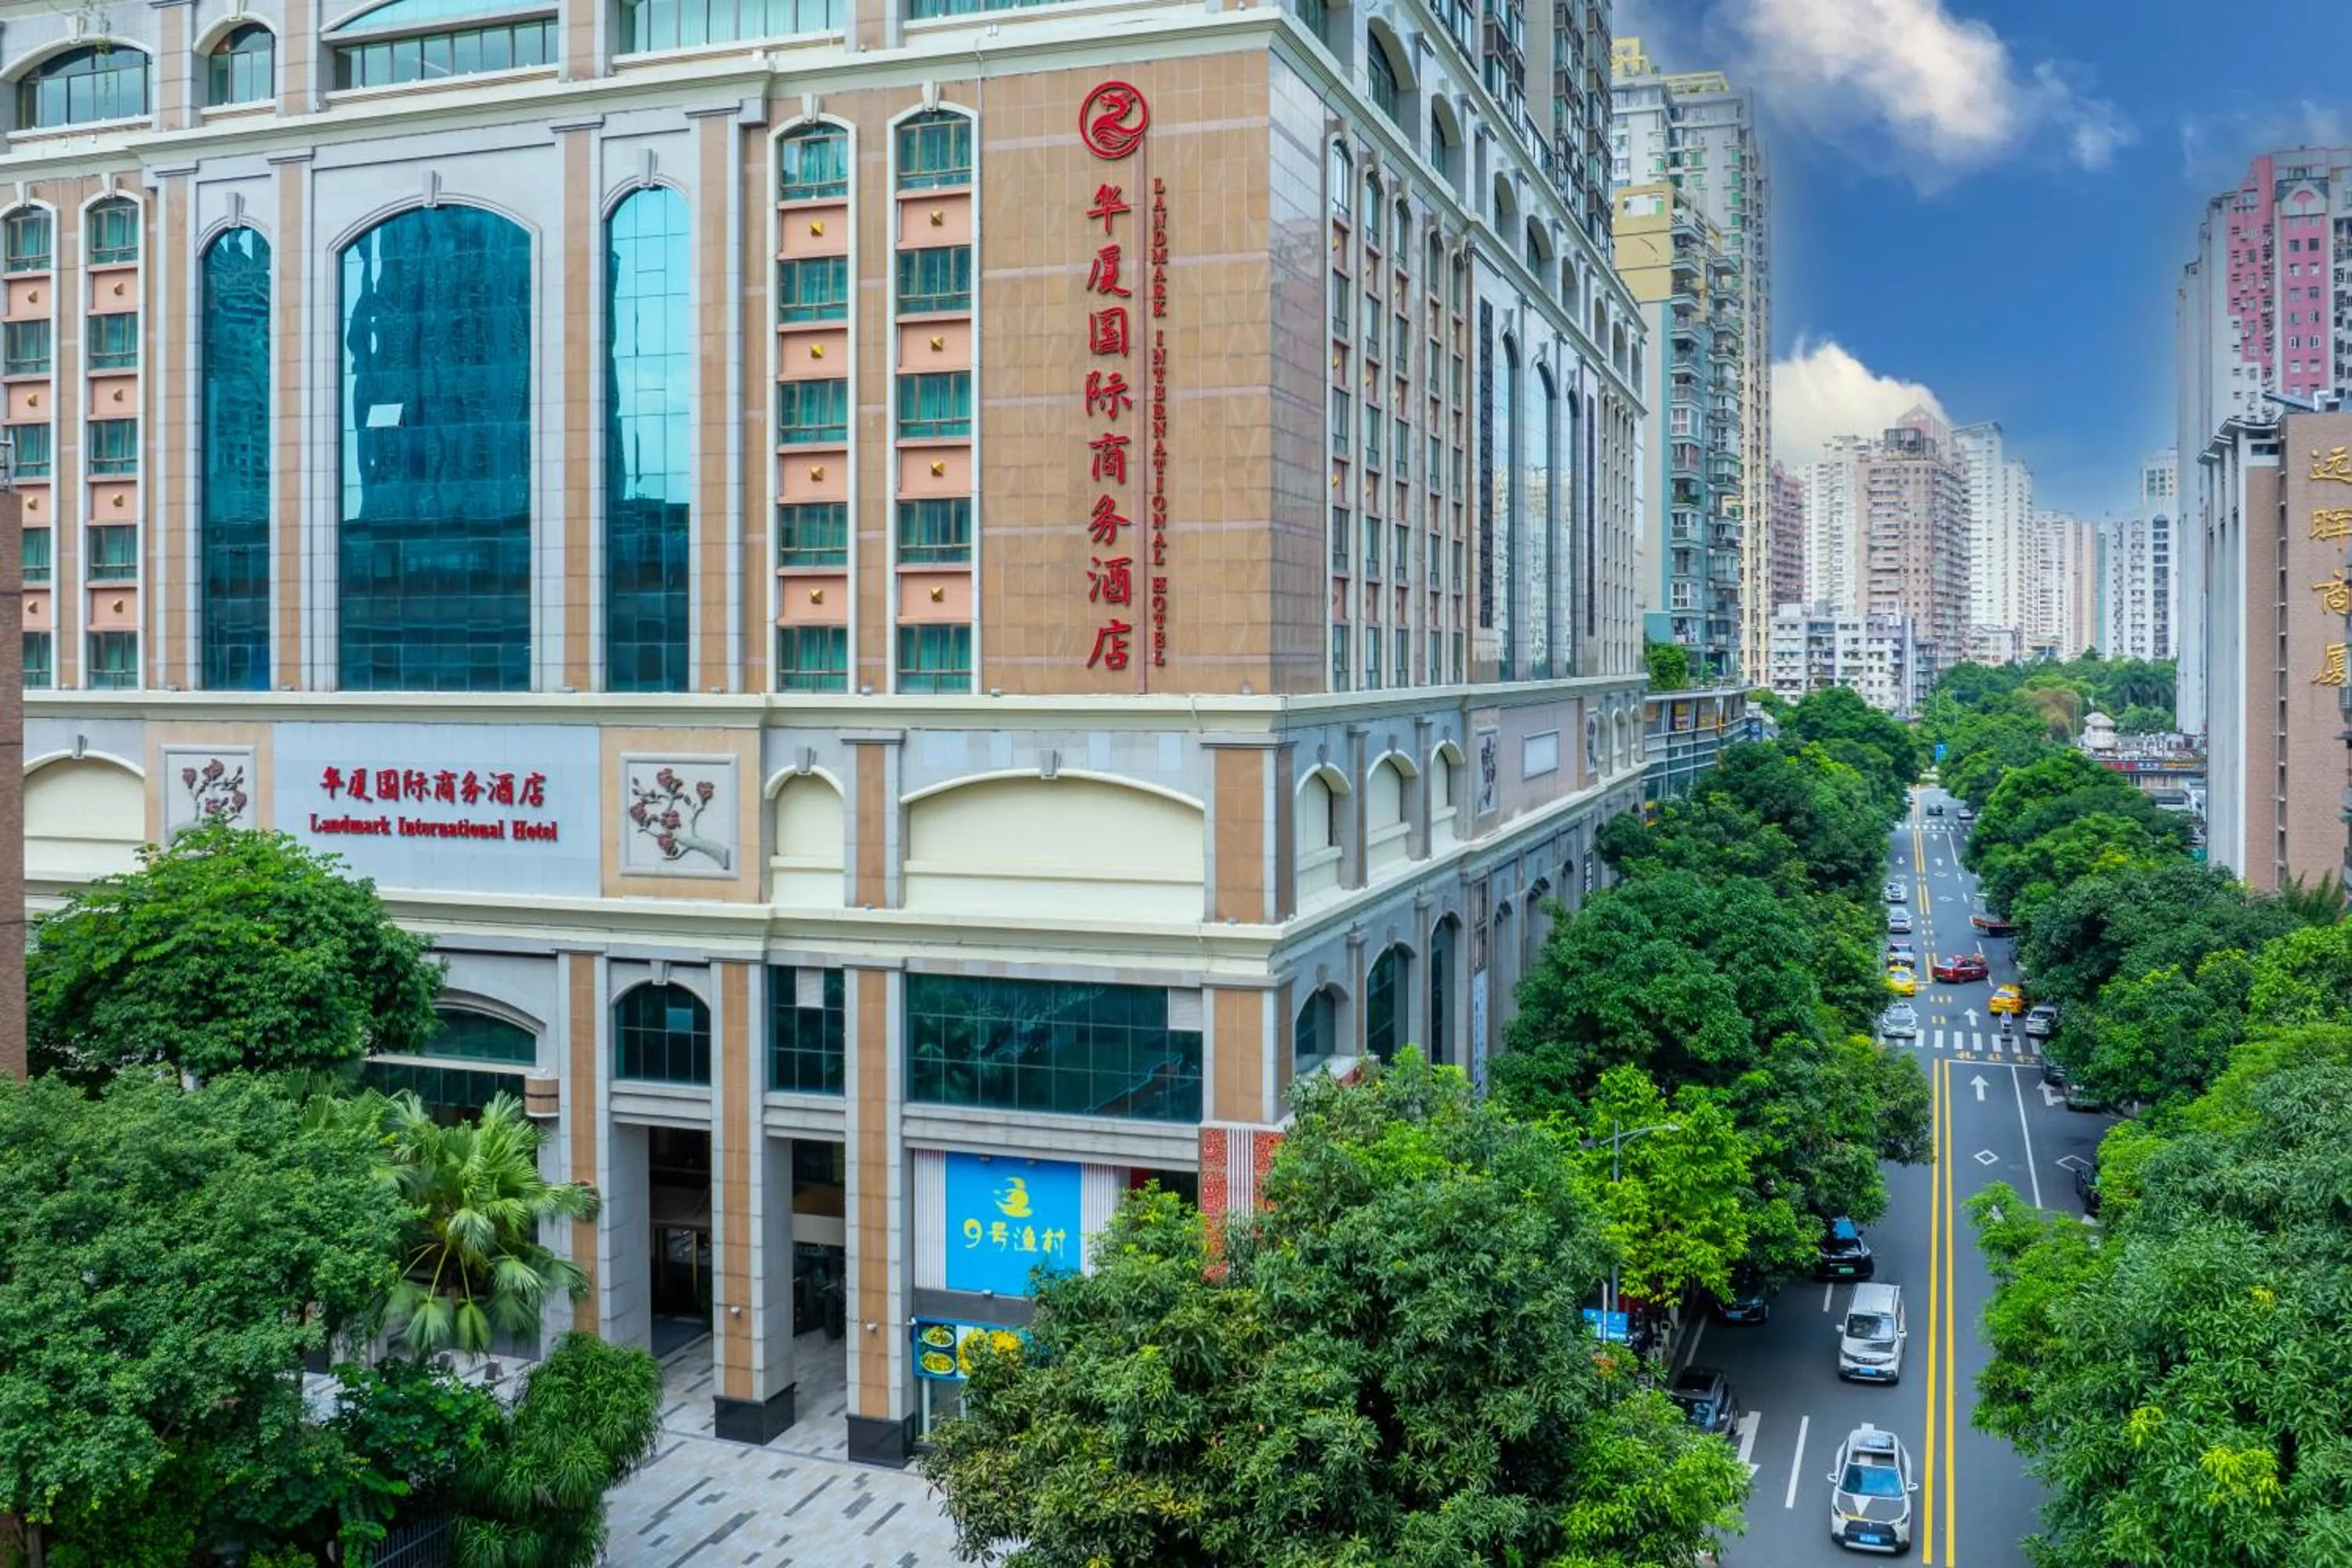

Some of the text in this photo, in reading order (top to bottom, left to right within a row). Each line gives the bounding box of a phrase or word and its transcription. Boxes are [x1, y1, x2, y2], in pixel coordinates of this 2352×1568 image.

[1084, 182, 1131, 670] 华厦国际商务酒店
[1152, 177, 1167, 667] LANDMARK INTERNATIONAL HOTEL
[319, 765, 547, 808] 华厦国际商务酒店
[310, 813, 558, 841] Landmark International Hotel
[963, 1218, 1066, 1259] 9号渔村
